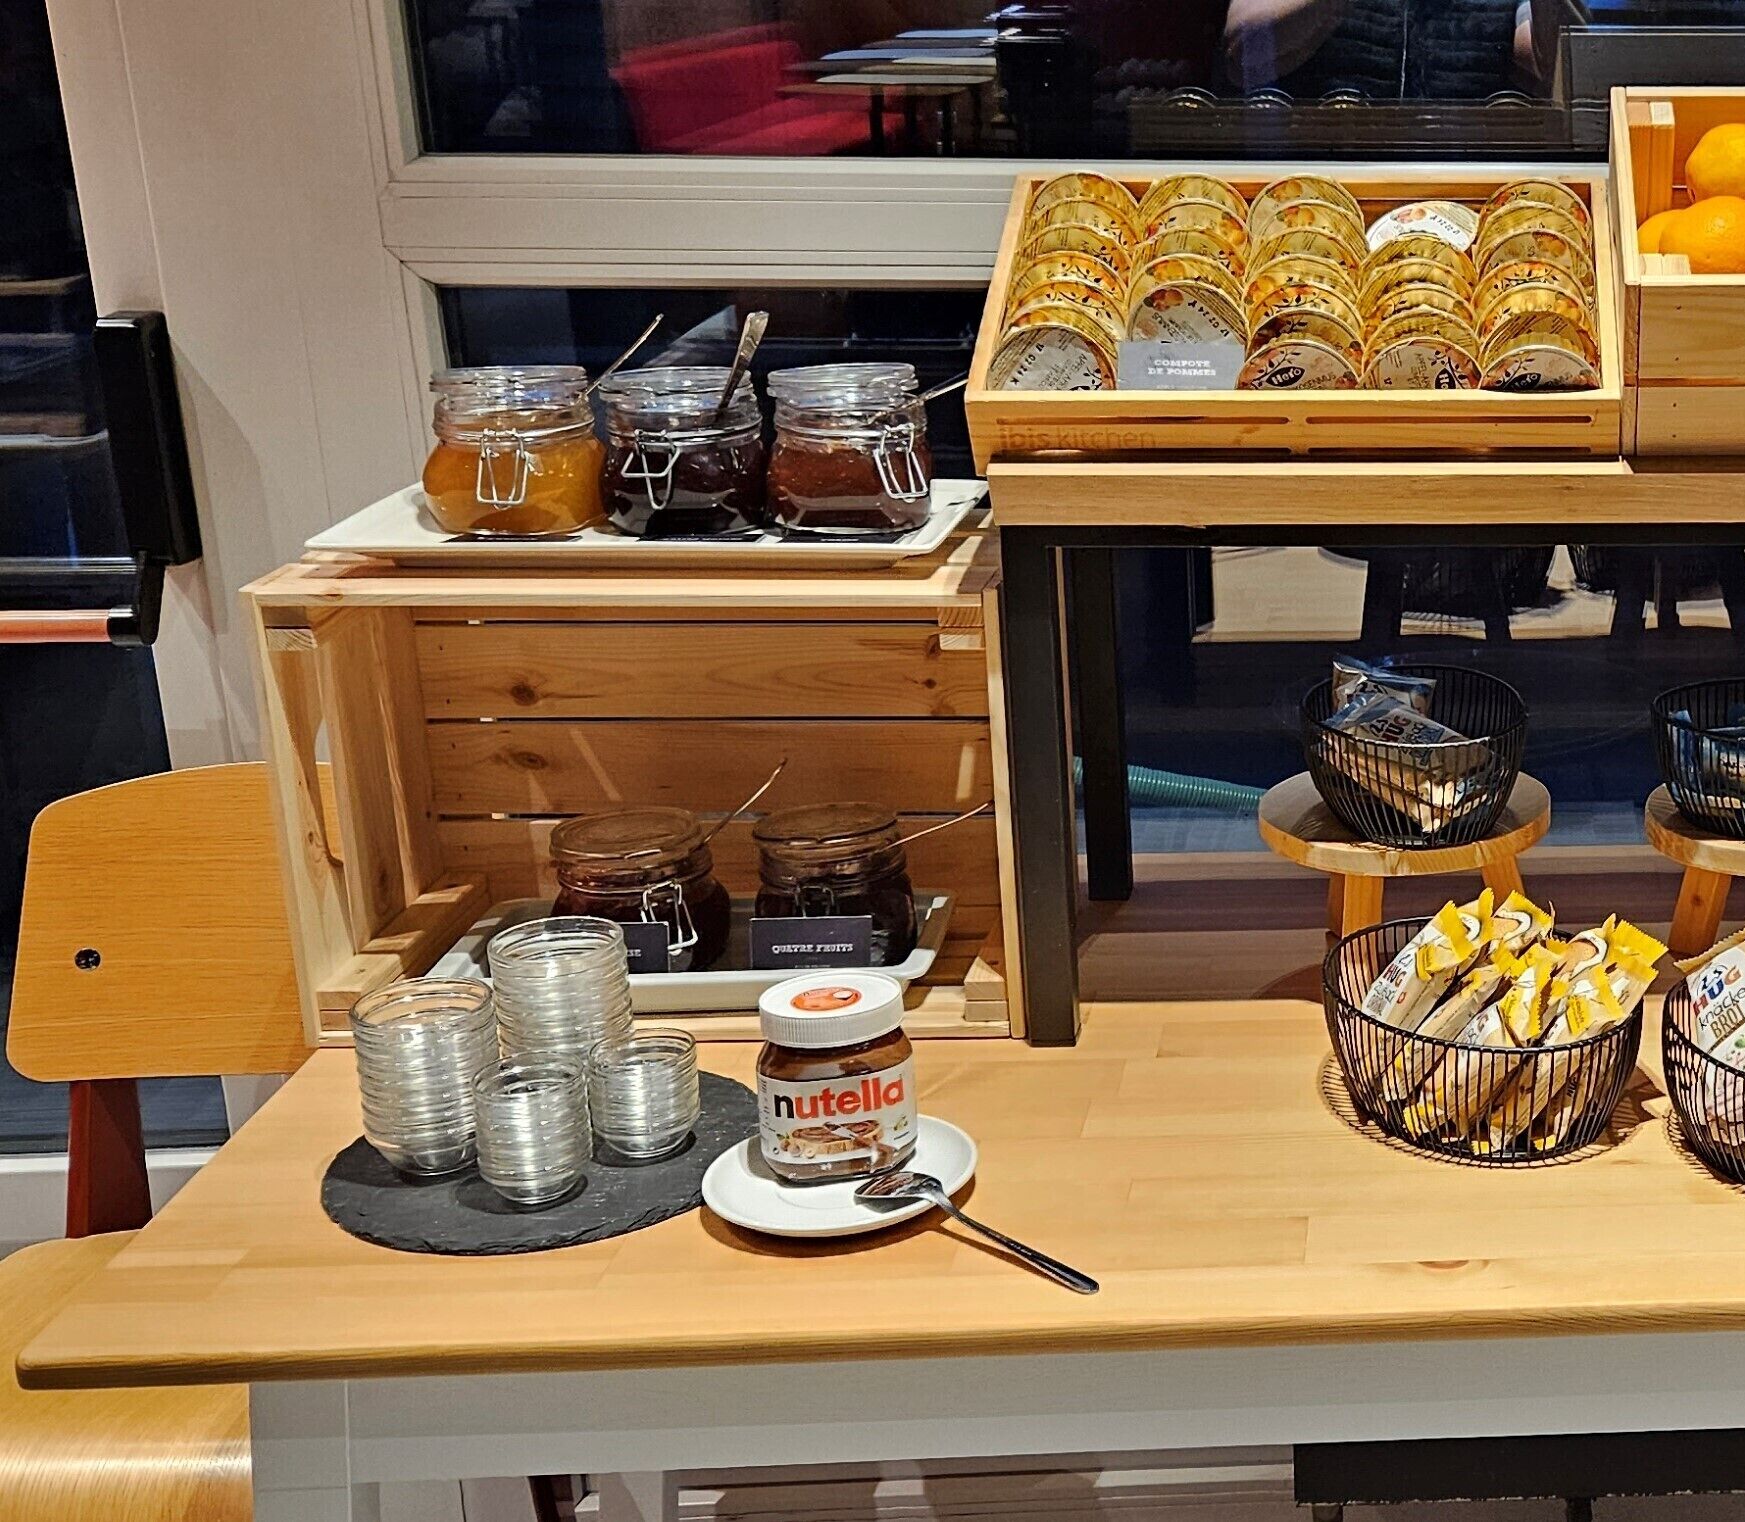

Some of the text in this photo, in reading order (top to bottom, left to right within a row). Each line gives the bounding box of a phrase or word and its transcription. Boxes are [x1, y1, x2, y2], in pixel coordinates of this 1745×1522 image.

[1154, 360, 1211, 368] COMPOTE
[1167, 368, 1217, 376] POMMES
[1271, 368, 1302, 385] Hero
[1000, 425, 1156, 449] ibis kitchen
[772, 944, 853, 954] QUATRE FRUITS
[1383, 963, 1407, 987] HUG
[1693, 965, 1741, 1016] HUG
[1710, 1003, 1745, 1039] BROT
[774, 1077, 905, 1120] nutella
